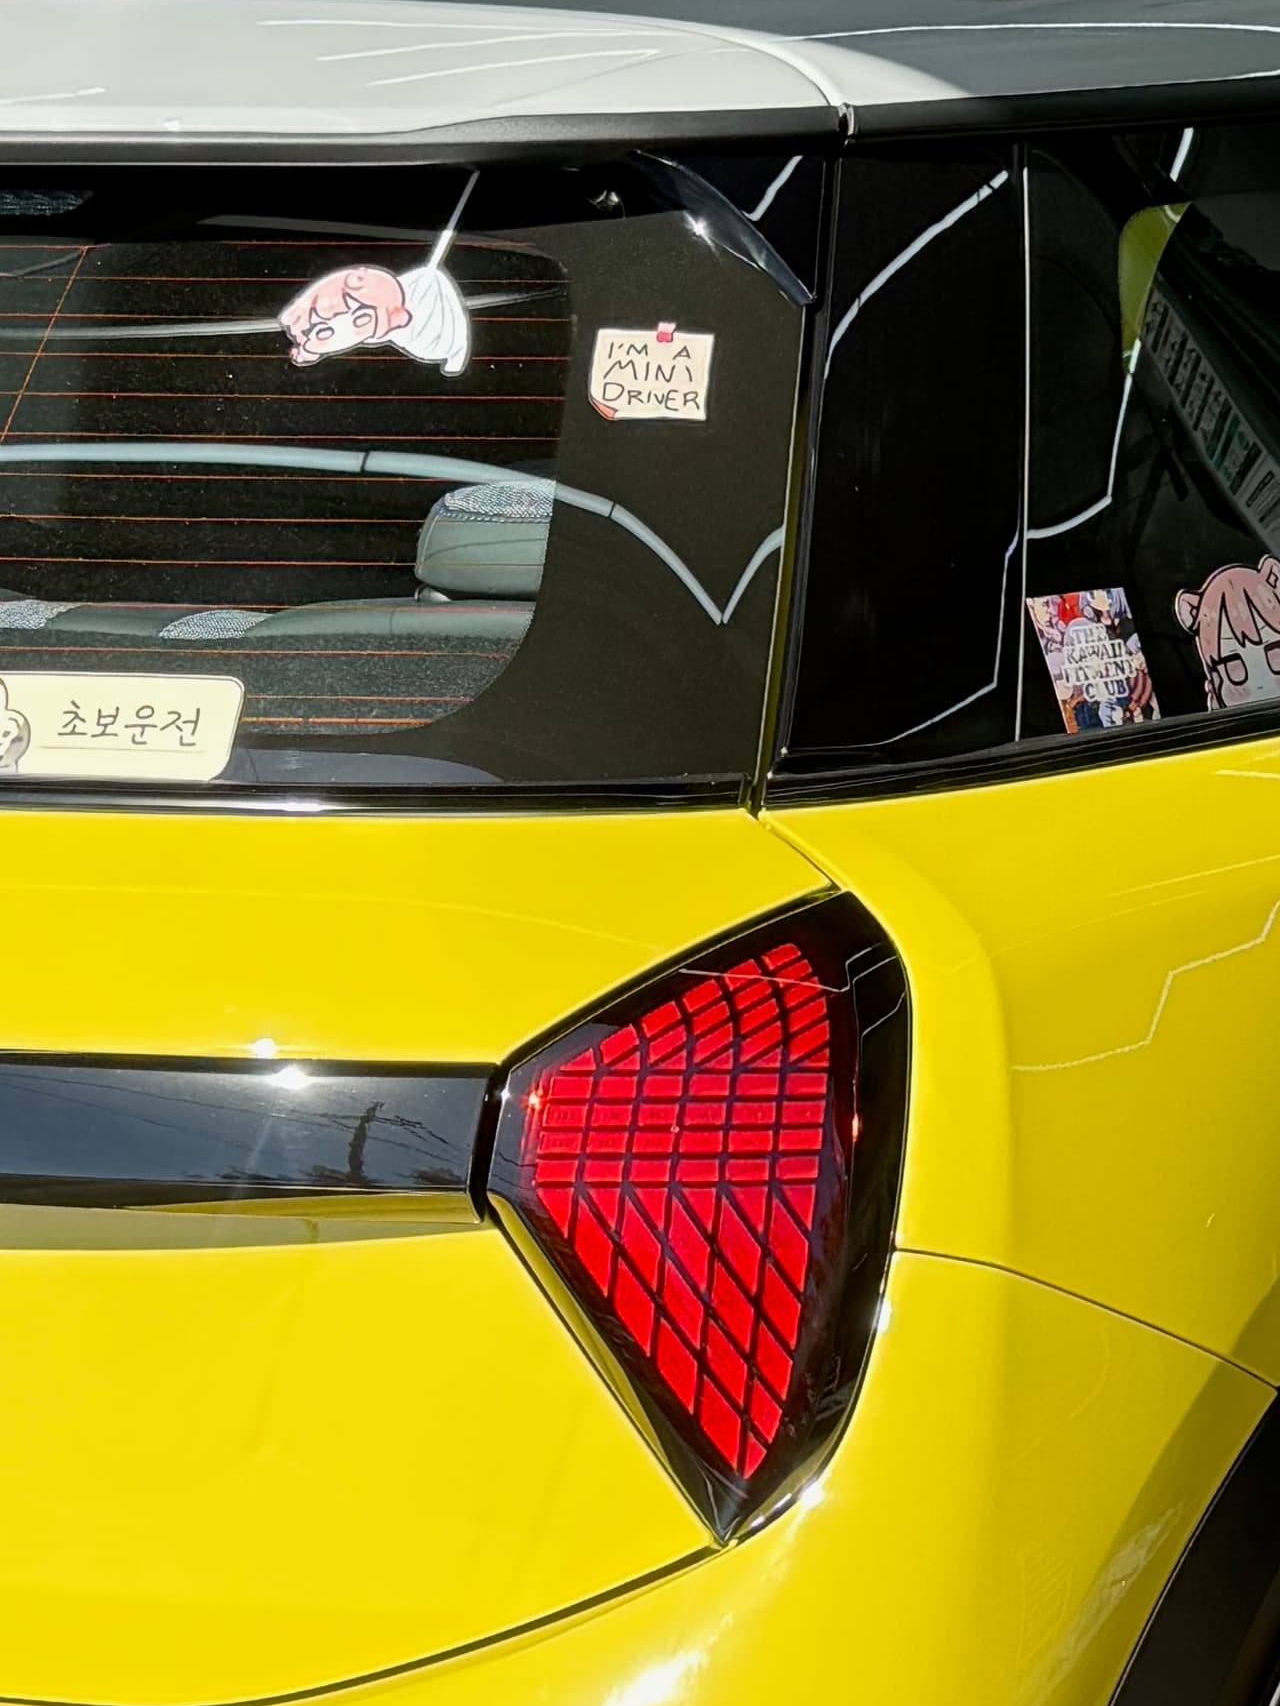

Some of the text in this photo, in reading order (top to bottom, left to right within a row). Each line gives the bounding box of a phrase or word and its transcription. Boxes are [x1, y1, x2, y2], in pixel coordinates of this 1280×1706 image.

[673, 345, 691, 360] A
[603, 359, 693, 383] MINI
[602, 381, 700, 411] DRIVER
[1065, 643, 1123, 664] KAWAII
[1085, 681, 1127, 699] CUB
[57, 699, 202, 747] 초보운전
